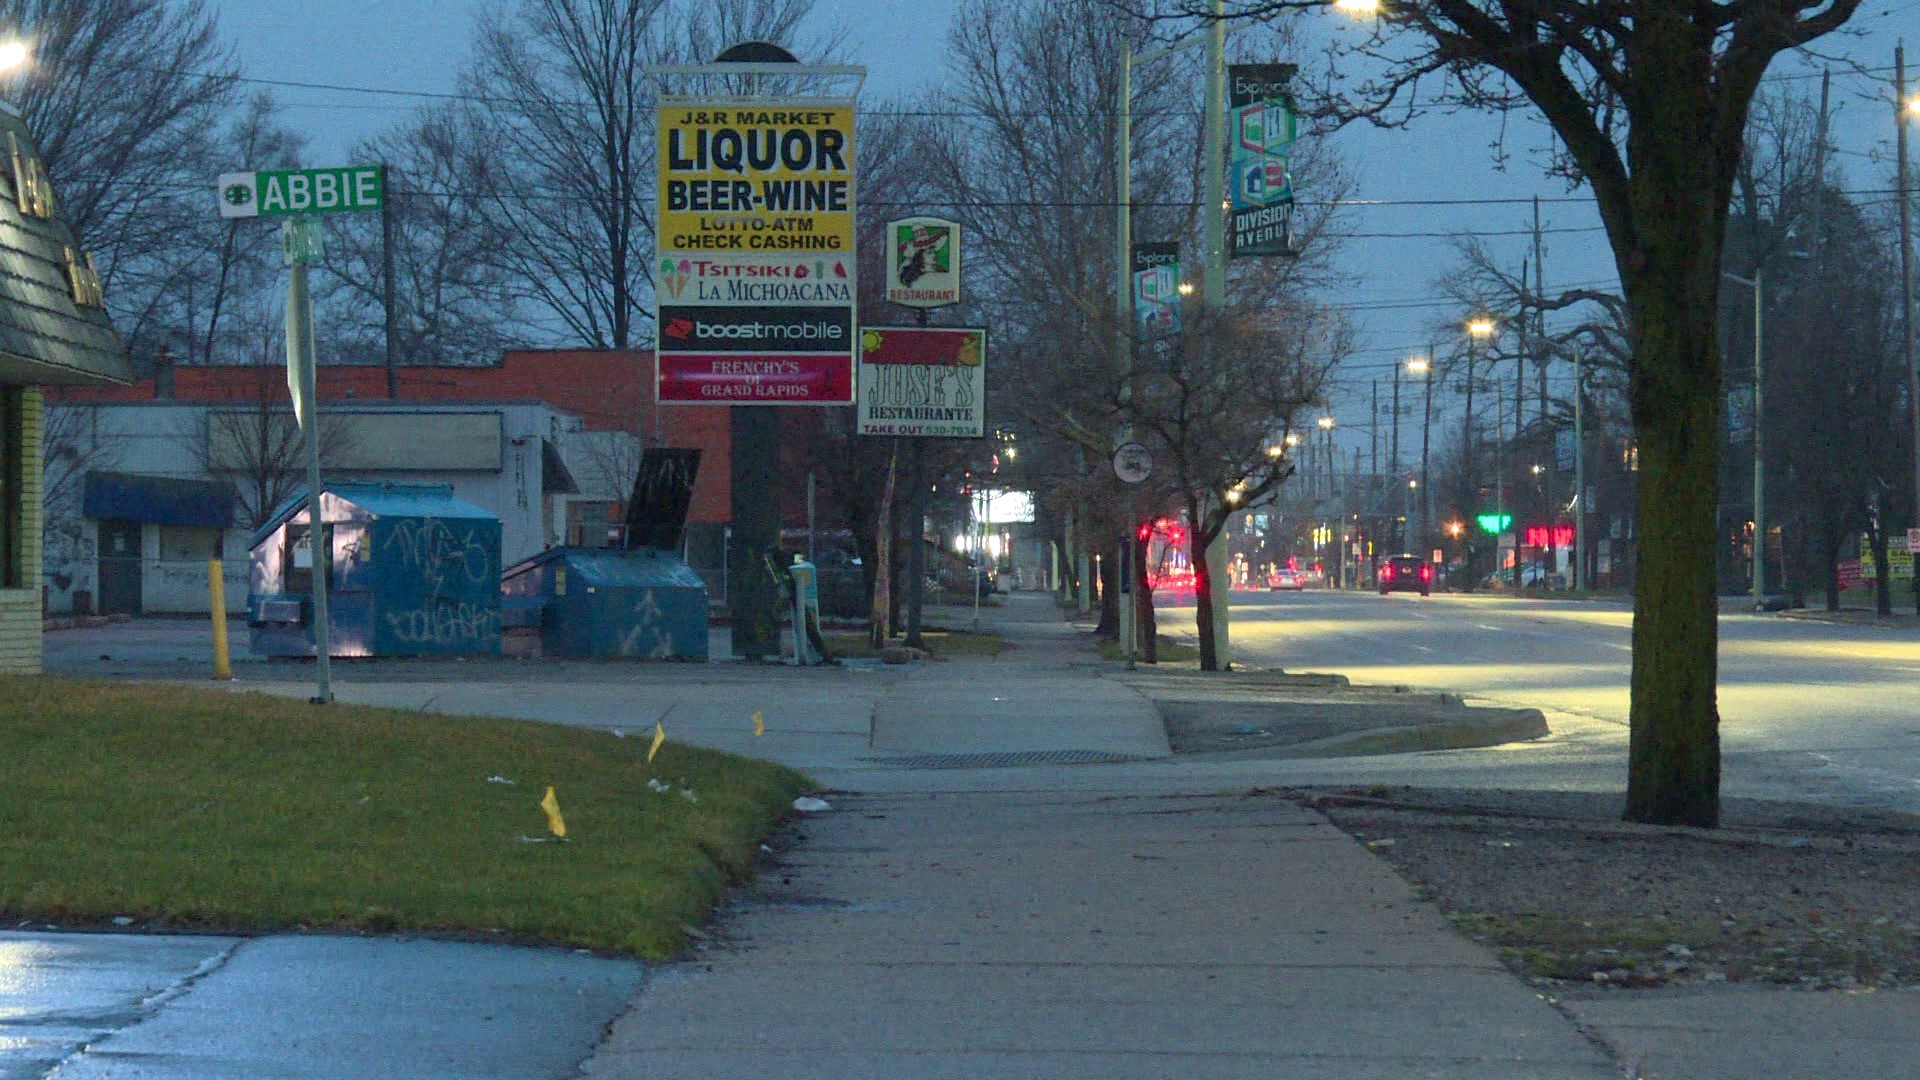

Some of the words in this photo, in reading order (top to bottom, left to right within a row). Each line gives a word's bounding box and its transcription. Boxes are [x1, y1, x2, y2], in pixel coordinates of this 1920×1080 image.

[680, 111, 729, 125] J&R
[736, 111, 836, 125] MARKET
[668, 128, 847, 174] LIQUOR
[263, 171, 378, 210] ABBIE
[667, 180, 848, 211] BEER-WINE
[700, 217, 814, 231] LOTTO-ATM
[673, 235, 743, 249] CHECK
[750, 235, 841, 249] CASHING
[1236, 223, 1286, 248] AVENU
[699, 281, 720, 300] LA
[727, 279, 850, 301] MICHOACANA
[890, 289, 955, 300] RESTAURANT
[711, 360, 800, 374] FRENCHY'S
[701, 385, 750, 396] GRAND
[755, 385, 809, 396] RAPIDS
[868, 364, 974, 407] JOSE'S
[868, 406, 973, 421] RESTAURANTE
[863, 424, 895, 434] TAKE
[898, 425, 924, 435] OUT
